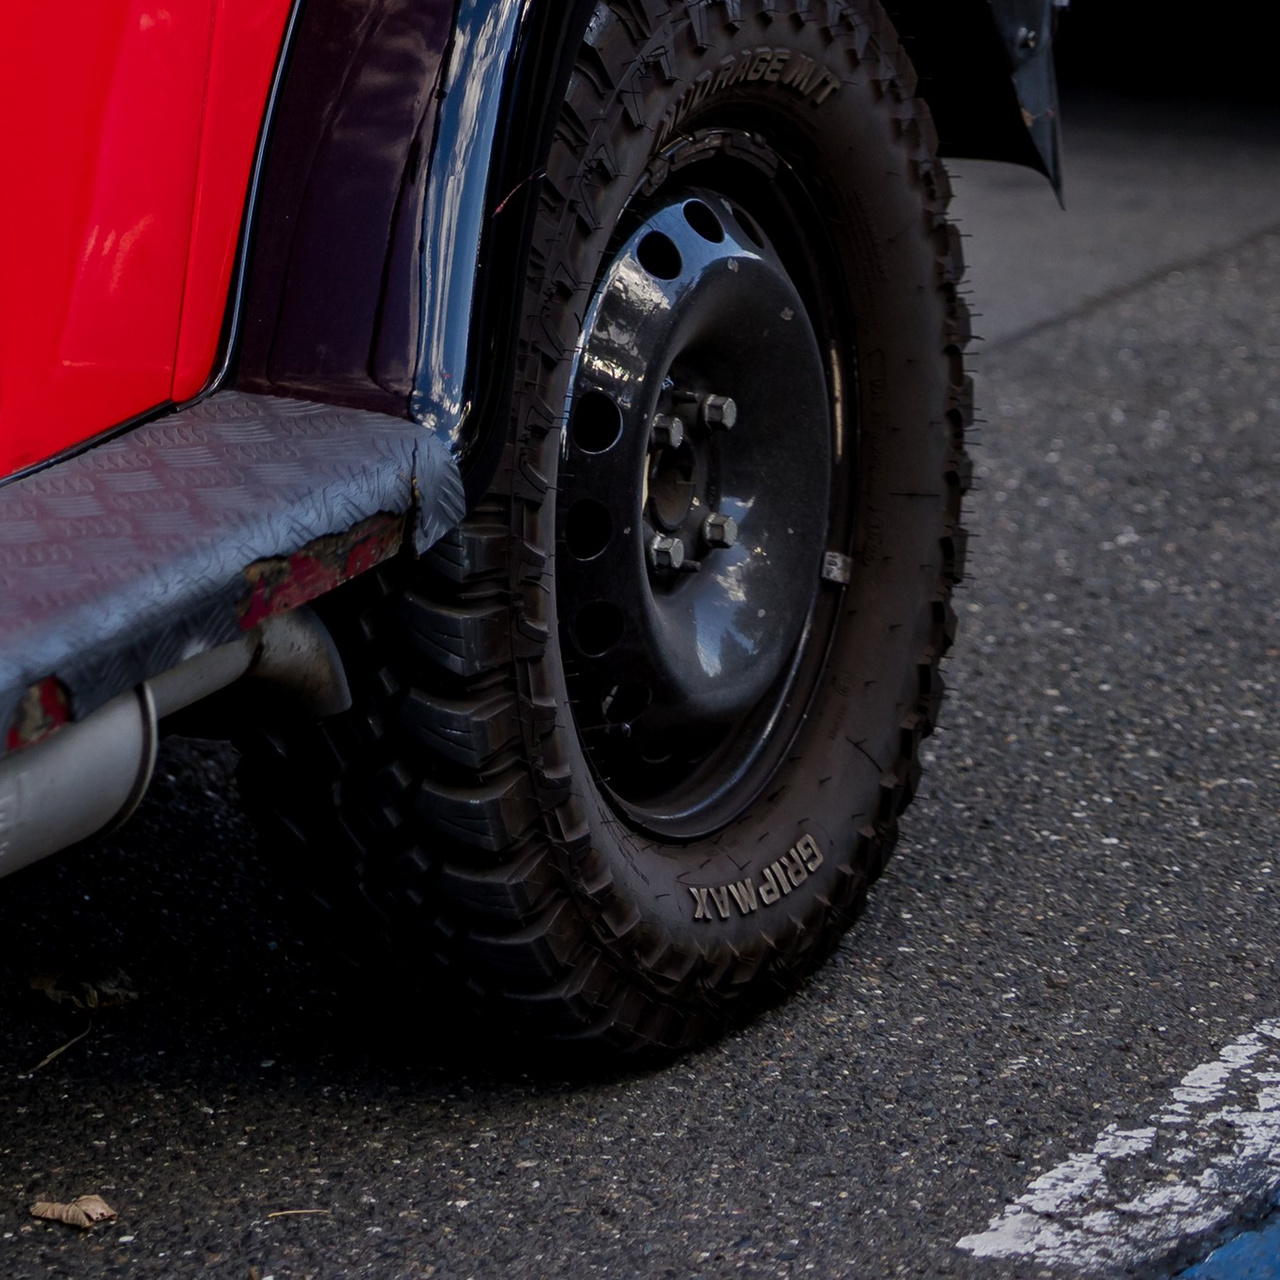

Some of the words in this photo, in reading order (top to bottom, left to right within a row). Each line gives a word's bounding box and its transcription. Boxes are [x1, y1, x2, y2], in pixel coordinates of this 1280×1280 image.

[712, 47, 791, 93] RAGE
[781, 53, 842, 107] M/T
[689, 833, 824, 920] GRIPMAX
